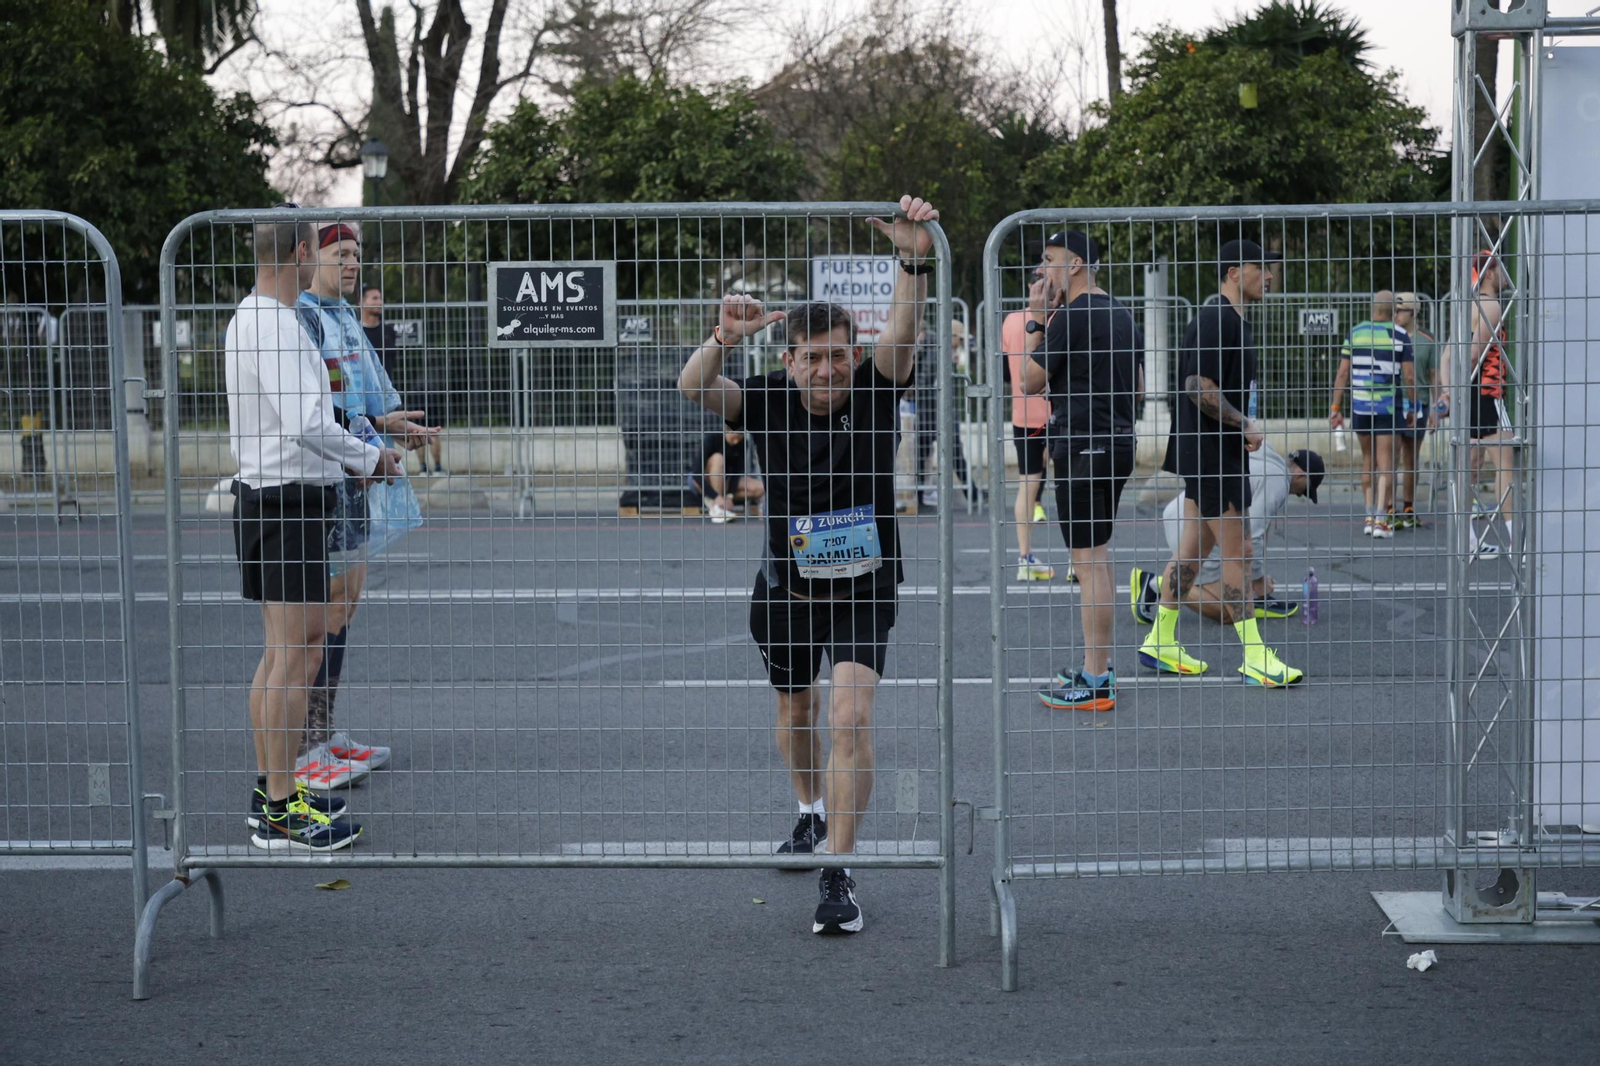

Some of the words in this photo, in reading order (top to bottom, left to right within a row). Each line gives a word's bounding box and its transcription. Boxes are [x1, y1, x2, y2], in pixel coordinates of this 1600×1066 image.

[821, 261, 889, 274] PUESTO
[516, 271, 585, 303] AMS
[823, 279, 892, 296] MÉDICO
[1308, 313, 1329, 325] AMS
[524, 324, 595, 336] alquiler-ms.com
[818, 512, 864, 527] ZURICH
[822, 536, 847, 547] 7207
[806, 546, 869, 564] SAMUEL
[1064, 690, 1091, 701] HOKA
